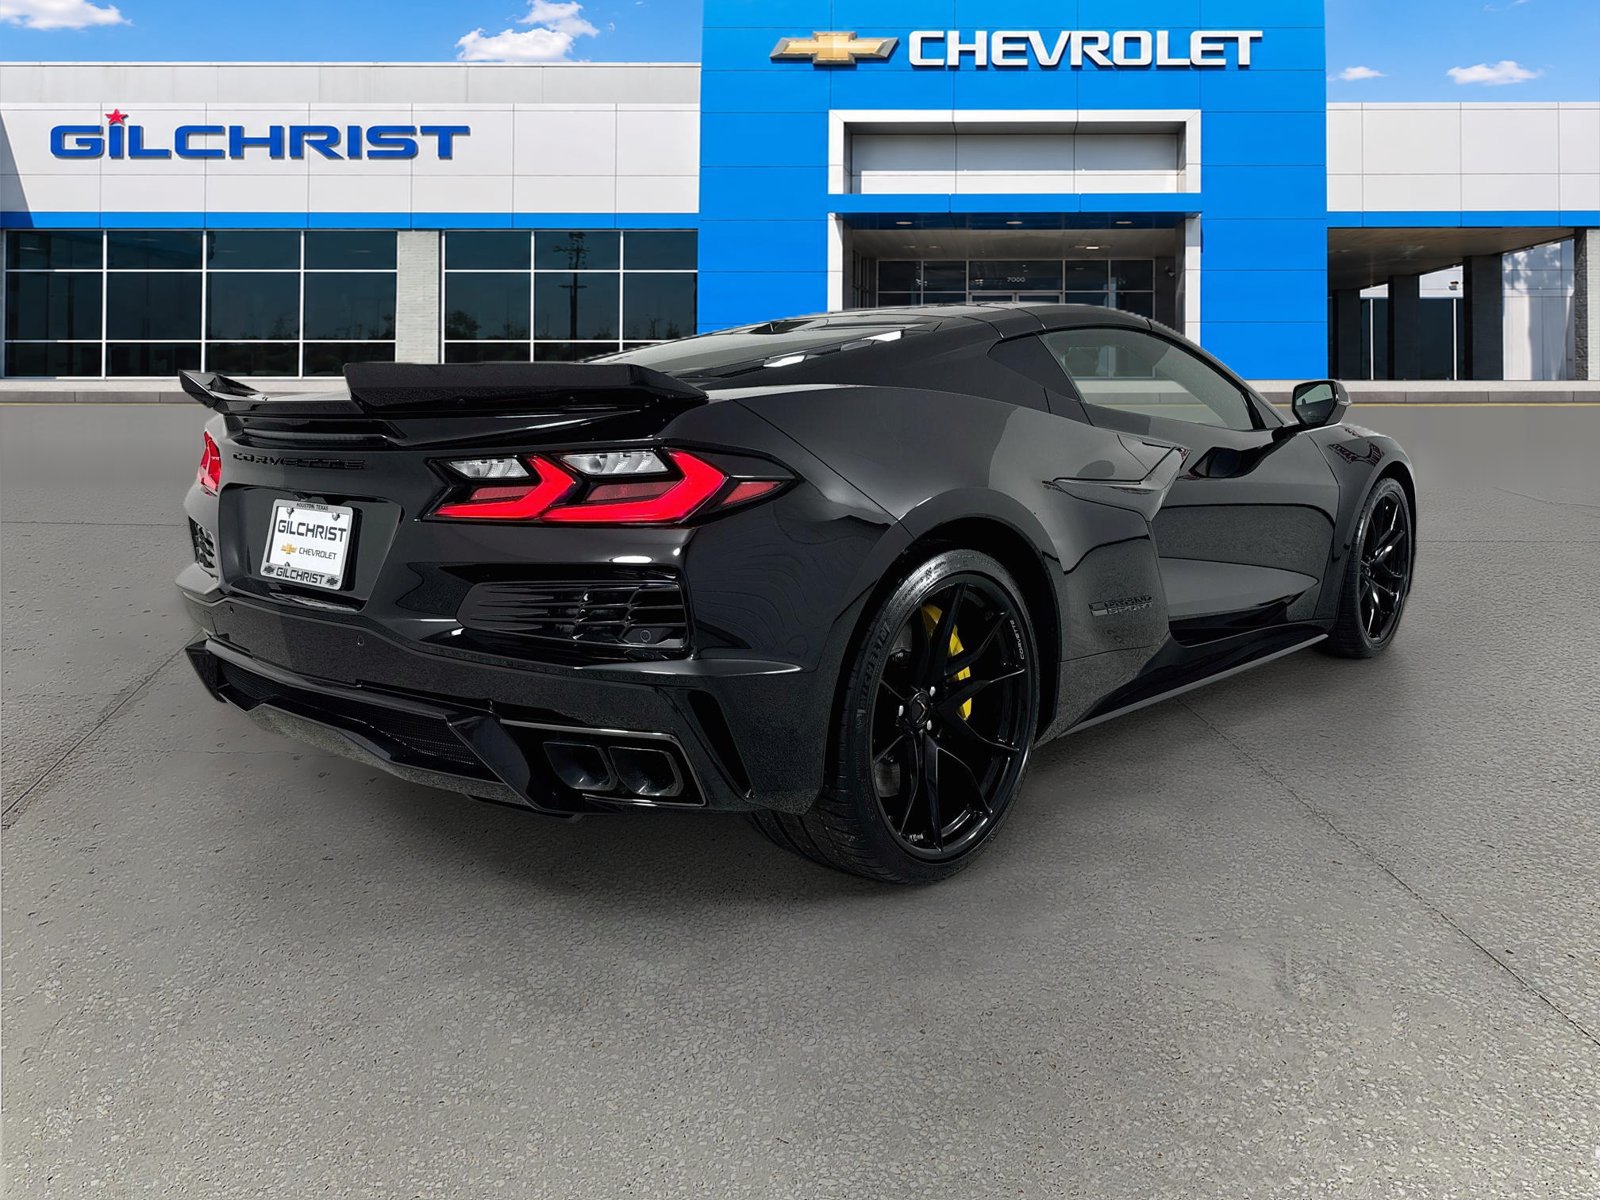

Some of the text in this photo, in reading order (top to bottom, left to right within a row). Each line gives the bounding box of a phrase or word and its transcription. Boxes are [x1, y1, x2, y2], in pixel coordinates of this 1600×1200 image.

[908, 30, 1263, 68] CHEVROLET
[50, 123, 471, 159] GILCHRIST
[232, 452, 365, 470] CORVETTE
[277, 519, 347, 542] GILCHRIST
[298, 547, 337, 560] CHEVROLET
[276, 566, 325, 584] GILCHRIST
